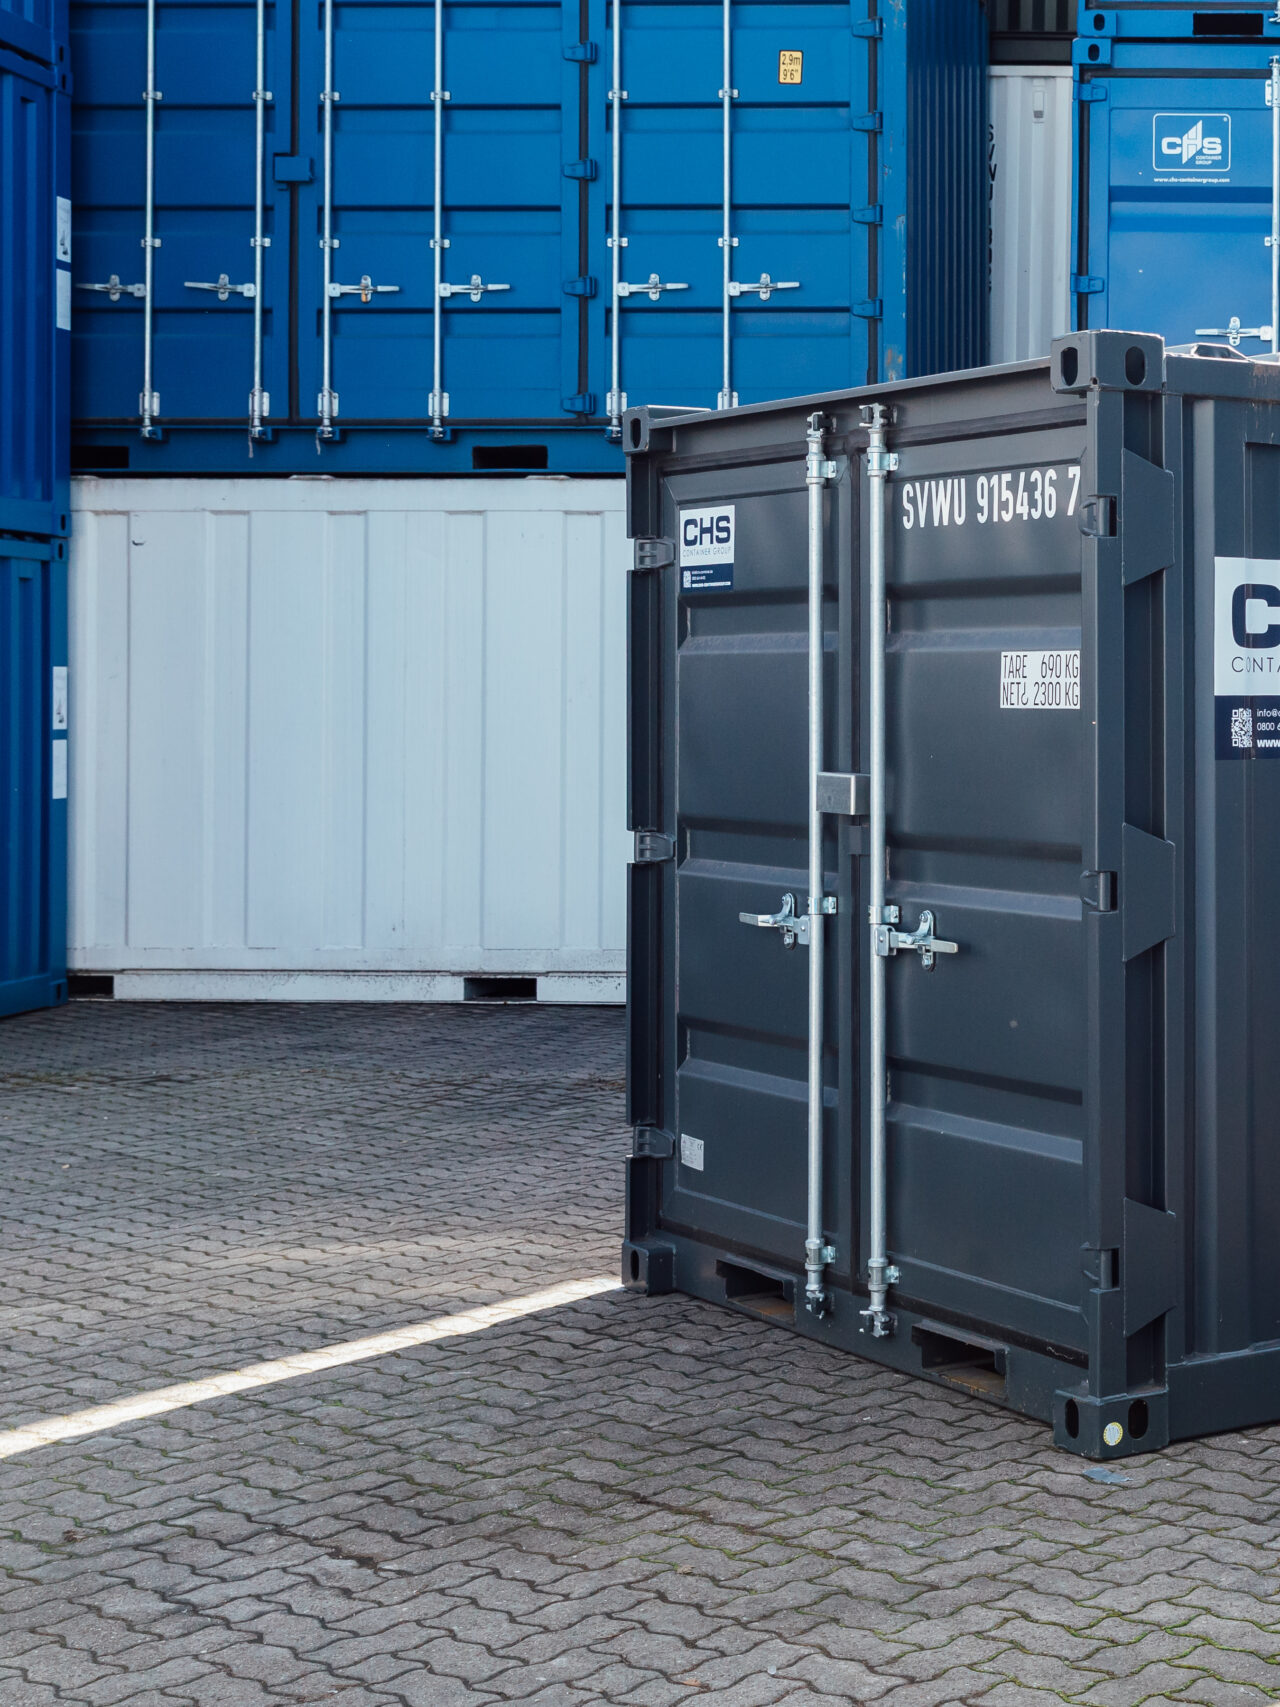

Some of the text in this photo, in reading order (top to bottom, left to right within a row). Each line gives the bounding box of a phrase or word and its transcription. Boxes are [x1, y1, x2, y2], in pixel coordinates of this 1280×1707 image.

[1161, 119, 1222, 165] CHS
[902, 466, 1081, 529] SVWU 915436 7
[684, 515, 731, 546] CHS
[1003, 654, 1079, 678] TARE 690 KG
[1033, 682, 1061, 706] 2300
[1065, 682, 1079, 706] KG
[1256, 722, 1275, 731] 0800
